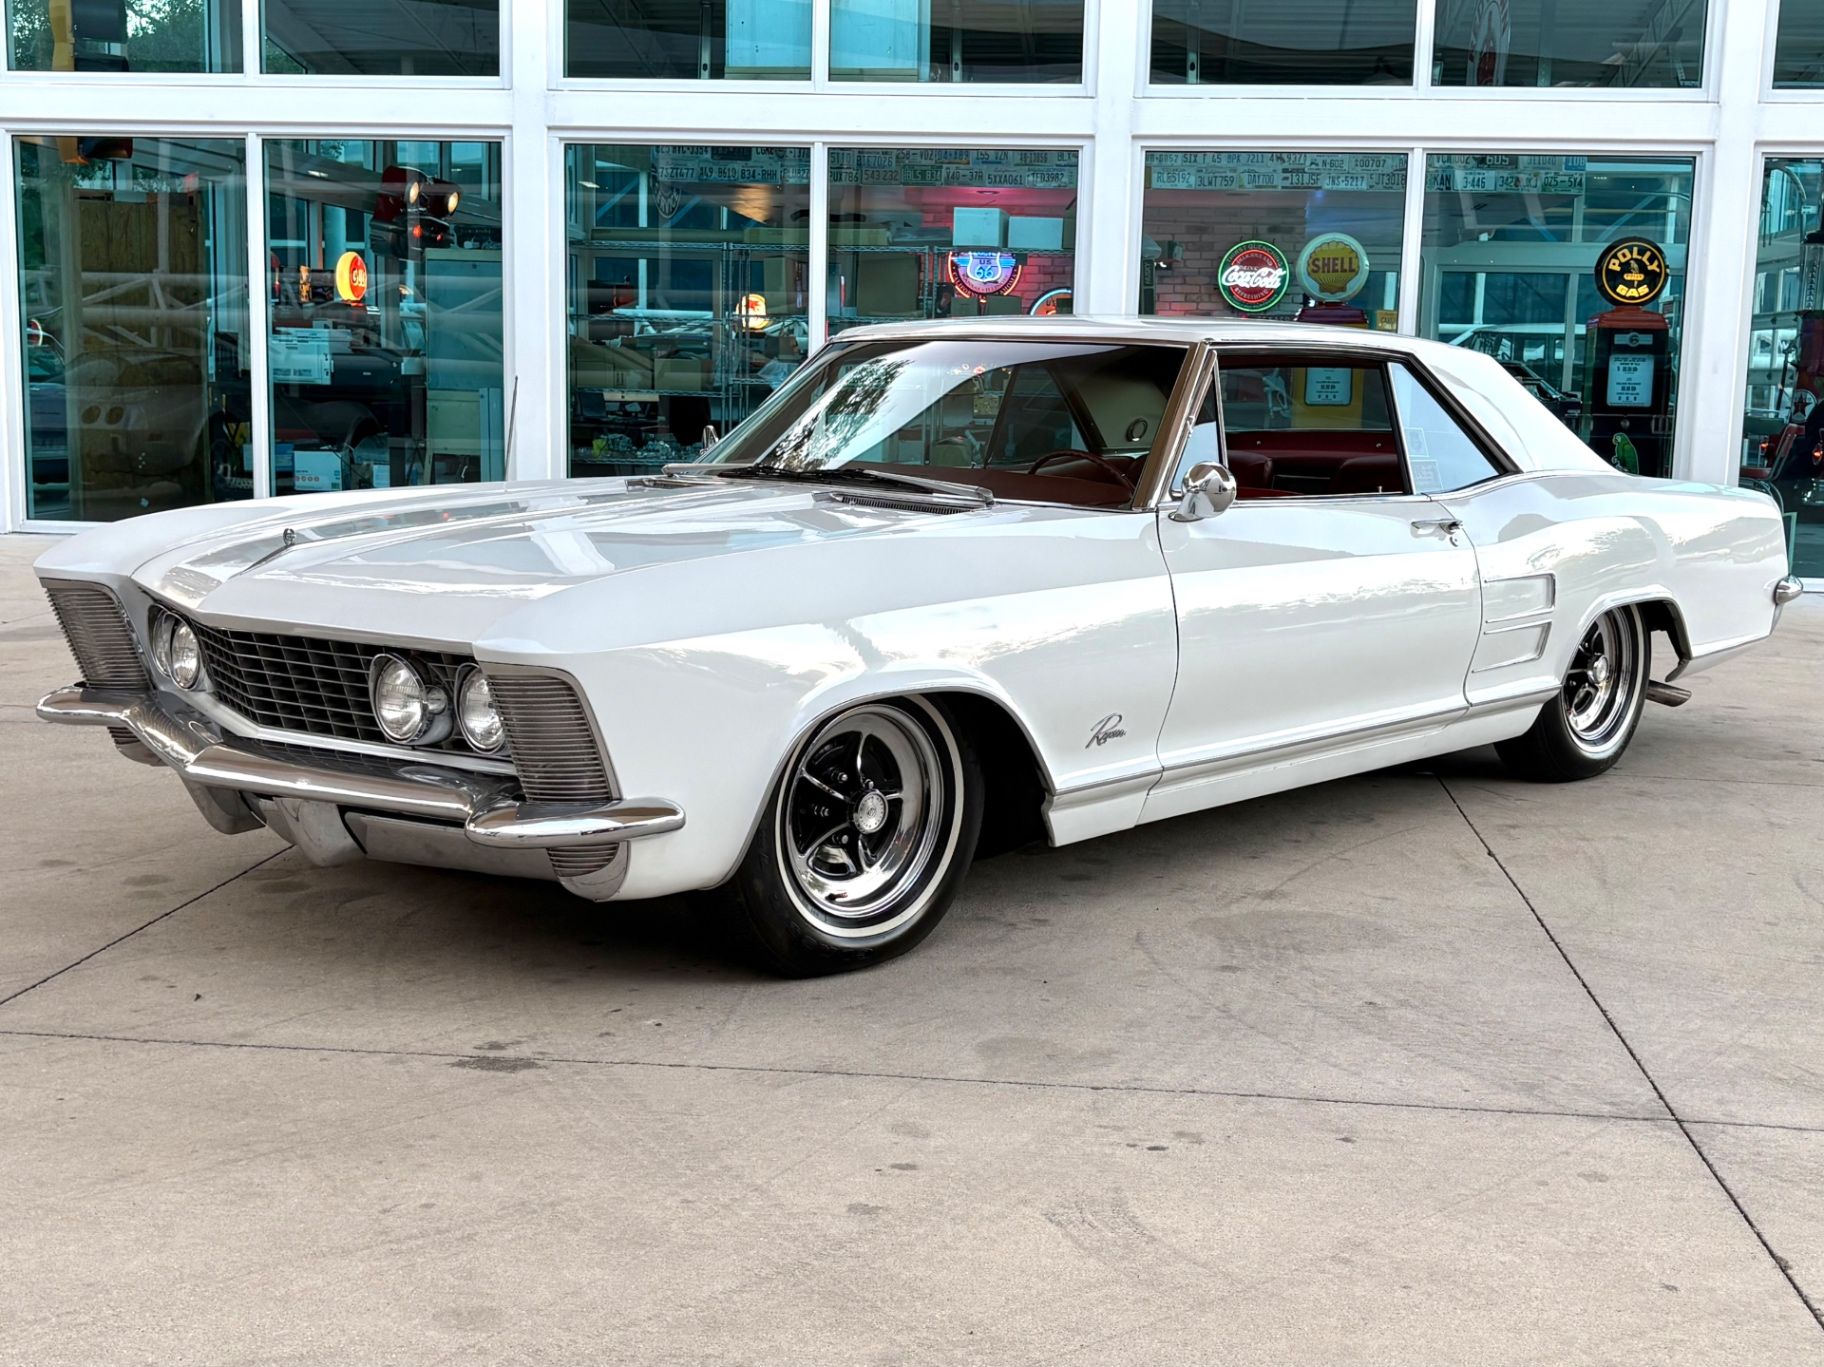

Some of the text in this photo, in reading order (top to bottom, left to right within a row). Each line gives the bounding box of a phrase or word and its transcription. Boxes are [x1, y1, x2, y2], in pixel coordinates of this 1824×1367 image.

[1311, 256, 1356, 274] SHELL
[1607, 245, 1661, 273] POLLY
[974, 265, 994, 278] 66
[1615, 283, 1650, 298] GAS
